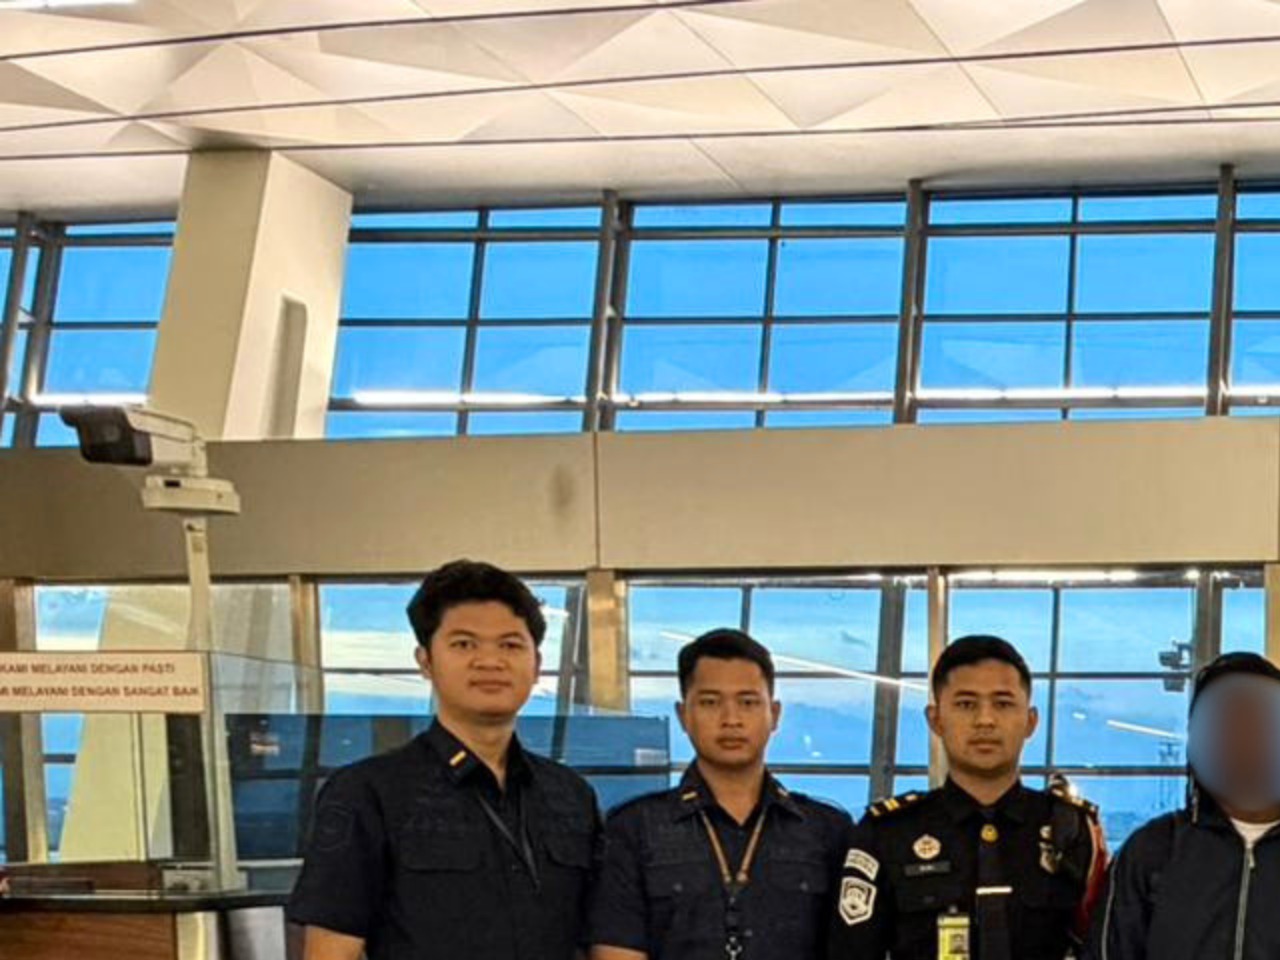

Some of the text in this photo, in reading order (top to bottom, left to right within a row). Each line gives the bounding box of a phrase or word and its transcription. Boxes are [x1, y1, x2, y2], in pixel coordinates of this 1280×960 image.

[31, 664, 87, 674] MELAYANI
[91, 664, 138, 674] DENGAN
[142, 664, 175, 674] PASTI
[12, 686, 69, 697] MELAYANI
[71, 686, 120, 697] DENGAN
[124, 686, 169, 697] SANGAT
